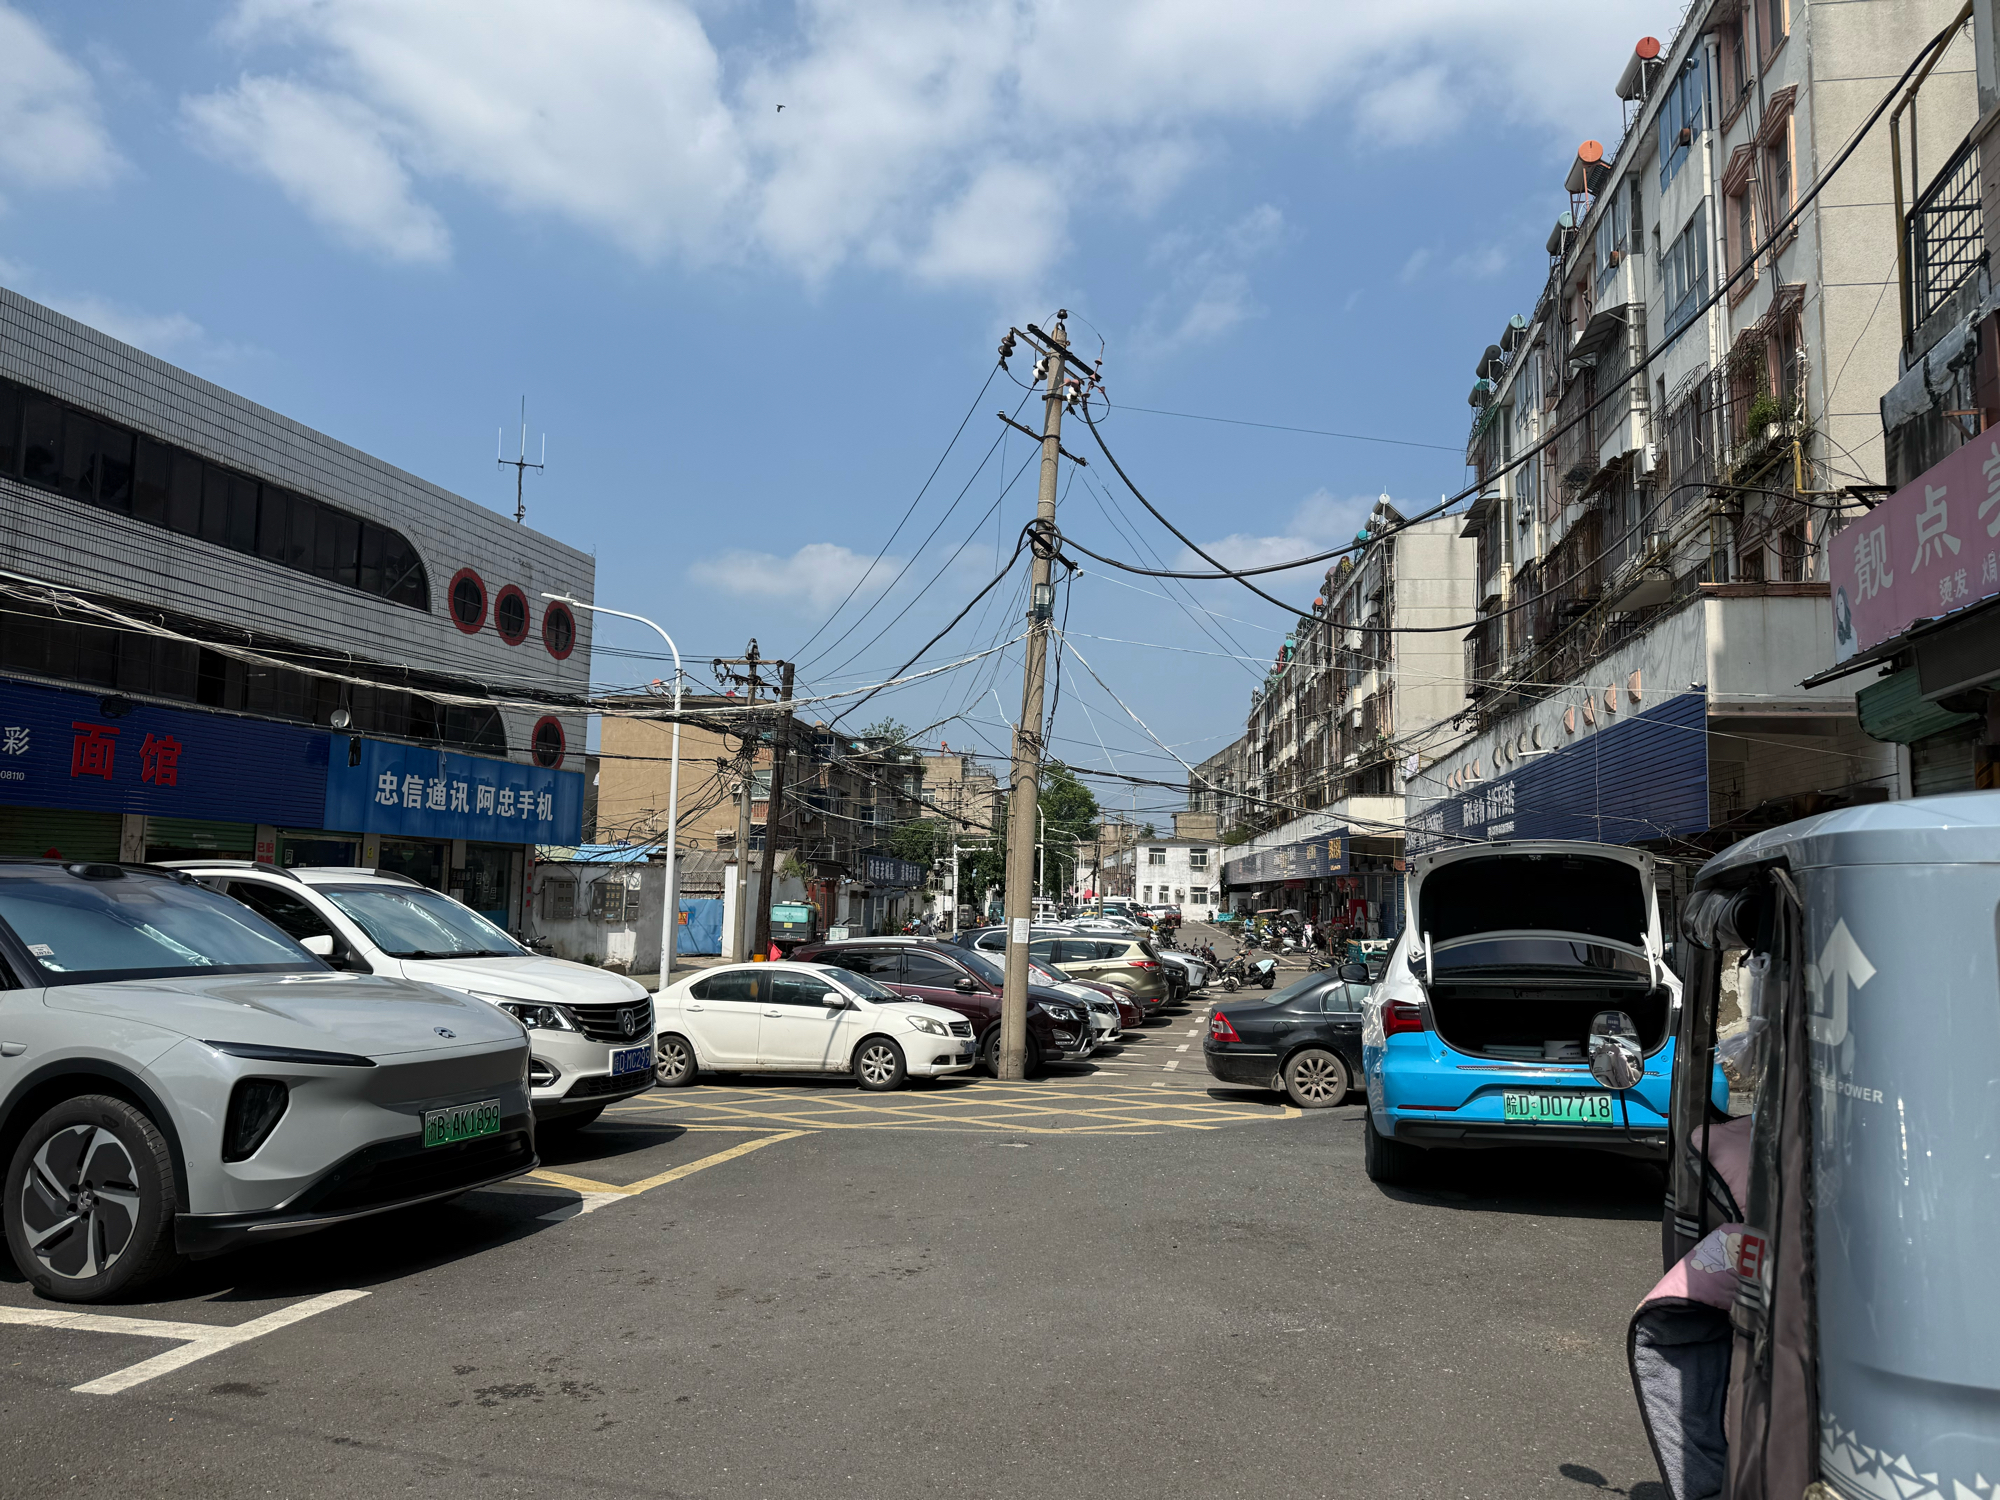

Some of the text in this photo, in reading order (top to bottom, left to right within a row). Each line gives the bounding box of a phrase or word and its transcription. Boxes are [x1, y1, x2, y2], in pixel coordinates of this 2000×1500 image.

[1939, 567, 1969, 607] 烫发
[2, 726, 30, 755] 彩
[71, 721, 182, 787] 面馆
[0, 770, 25, 781] 08110
[374, 771, 553, 821] 忠信通讯 阿忠手机
[1837, 1081, 1884, 1104] POWER
